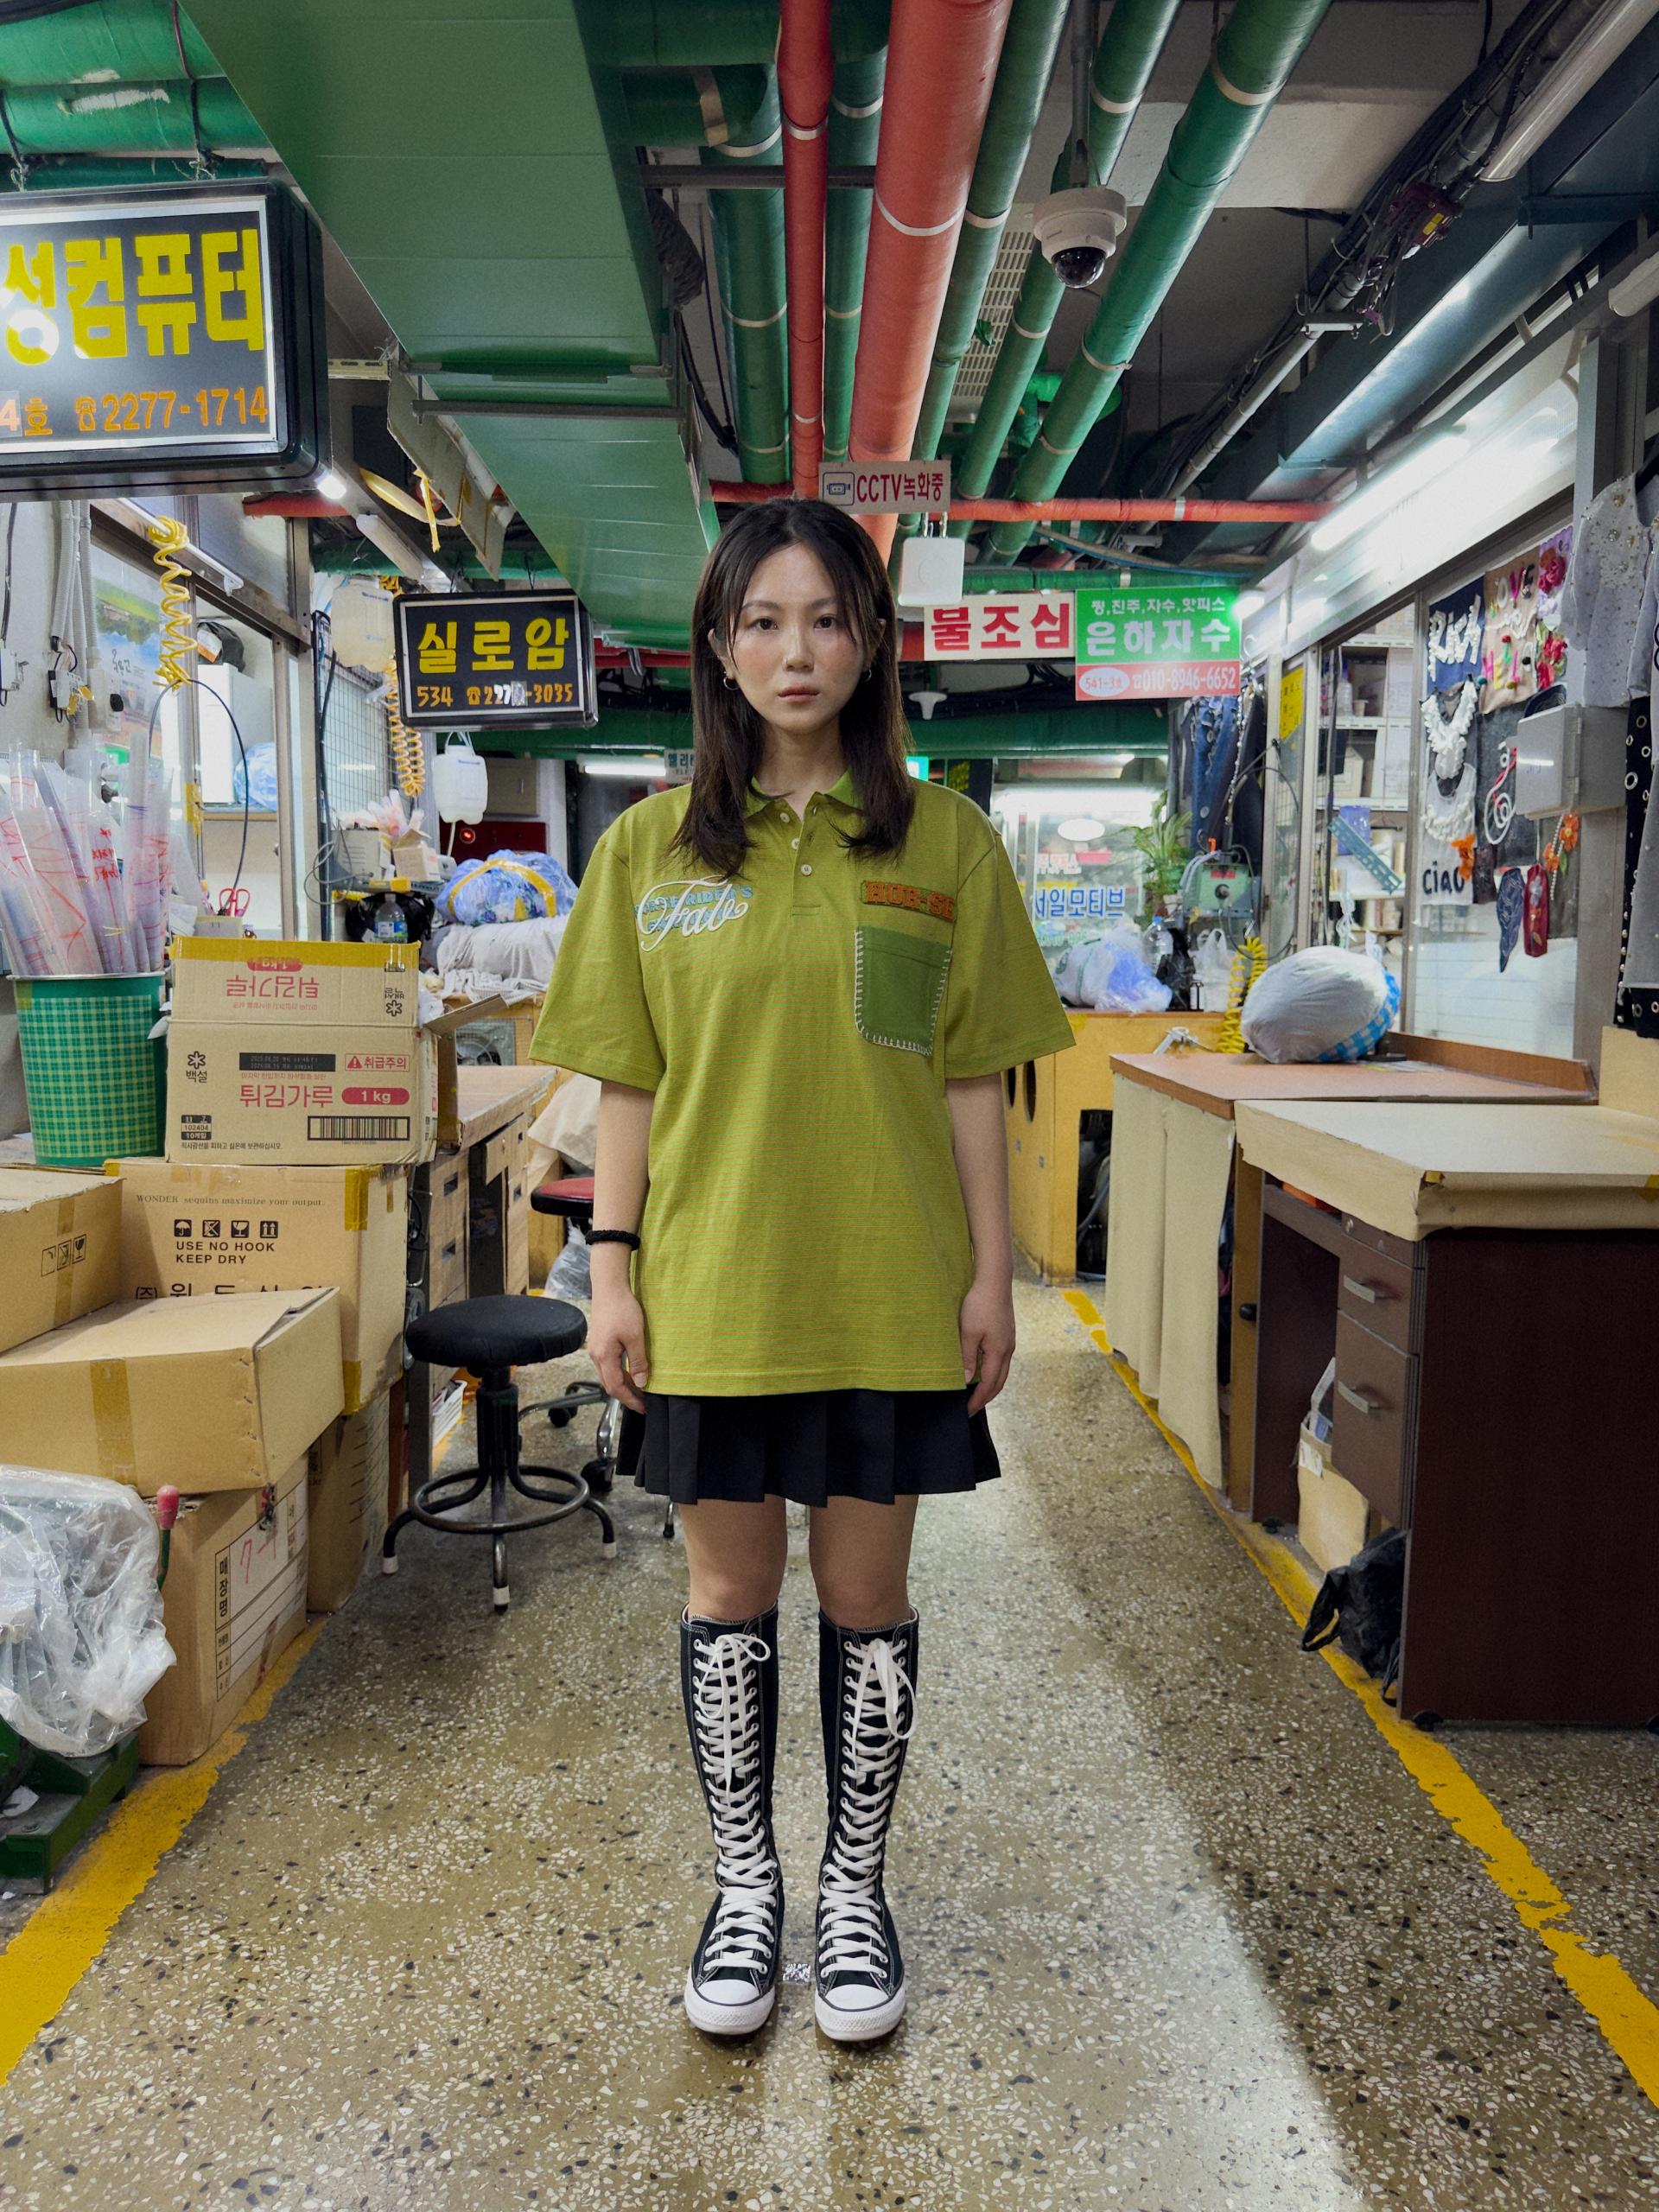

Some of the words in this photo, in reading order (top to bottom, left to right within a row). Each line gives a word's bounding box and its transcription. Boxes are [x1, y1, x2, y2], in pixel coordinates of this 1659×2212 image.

[3, 228, 264, 366] 성컴퓨터
[103, 386, 268, 431] 2277-1714
[856, 472, 944, 504] CCTV녹화중
[930, 602, 1071, 653] 불조심
[1086, 618, 1231, 657] 은하자수
[417, 617, 569, 674] 실로암
[416, 685, 454, 708] 534
[226, 975, 321, 999] 튀김가루
[364, 1056, 407, 1071] 취급주의
[186, 1070, 207, 1083] 백설
[239, 1084, 334, 1109] 튀김가루
[361, 1091, 368, 1102] 1
[373, 1090, 391, 1103] kg
[137, 1194, 179, 1204] WONDER
[221, 1197, 266, 1205] maximize
[270, 1198, 289, 1207] your
[176, 1241, 204, 1251] USE
[209, 1242, 229, 1251] NO
[234, 1243, 276, 1252] HOOK
[176, 1255, 213, 1263] KEEP
[218, 1255, 247, 1264] DRY
